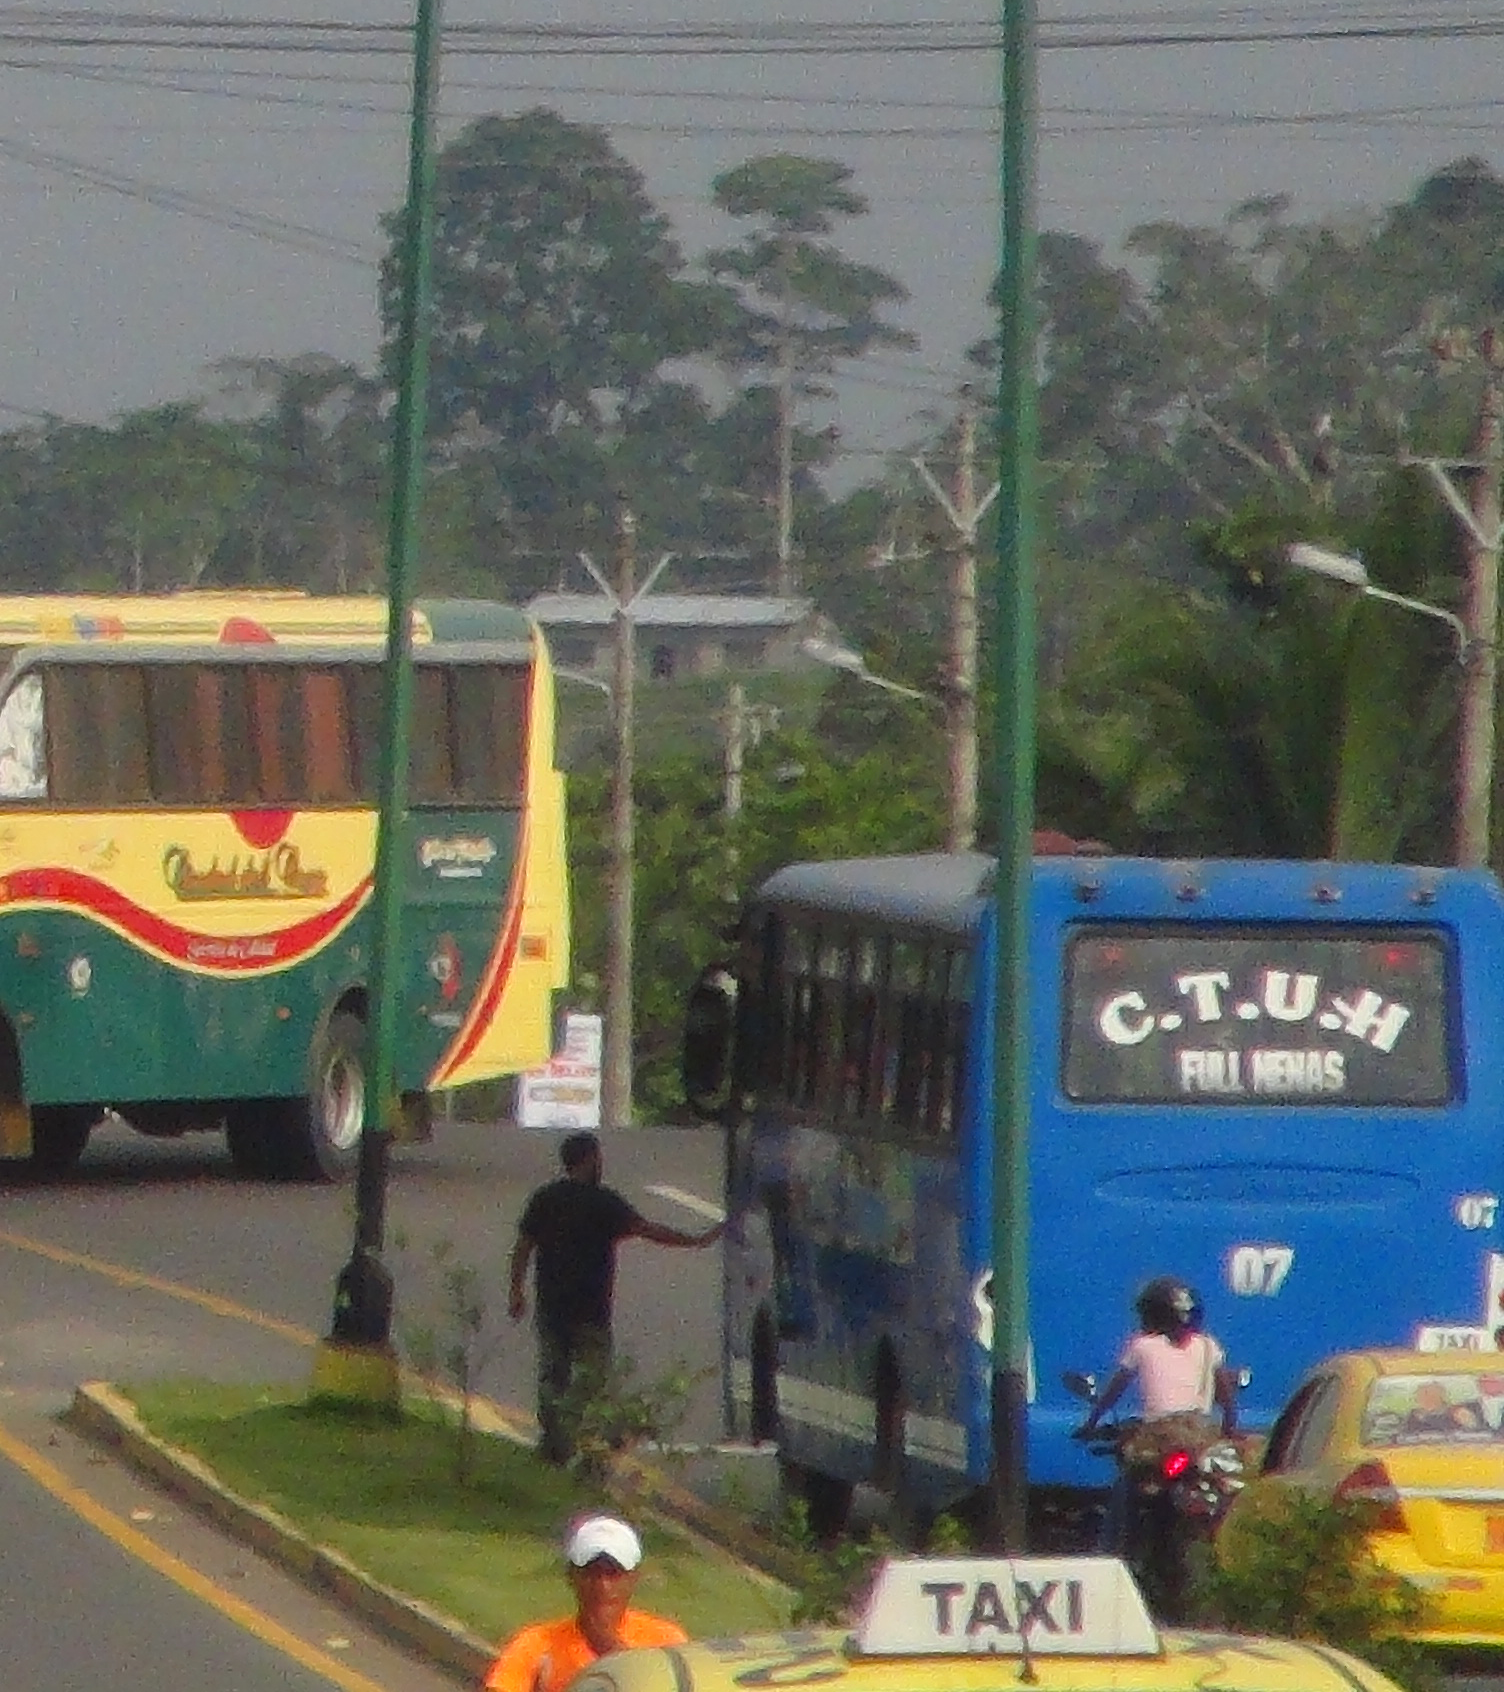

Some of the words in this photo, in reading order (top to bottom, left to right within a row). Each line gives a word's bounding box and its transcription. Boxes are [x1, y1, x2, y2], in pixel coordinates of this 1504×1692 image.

[1457, 1194, 1500, 1231] 07
[1229, 1244, 1296, 1297] 07
[920, 1581, 1085, 1636] TAXI
